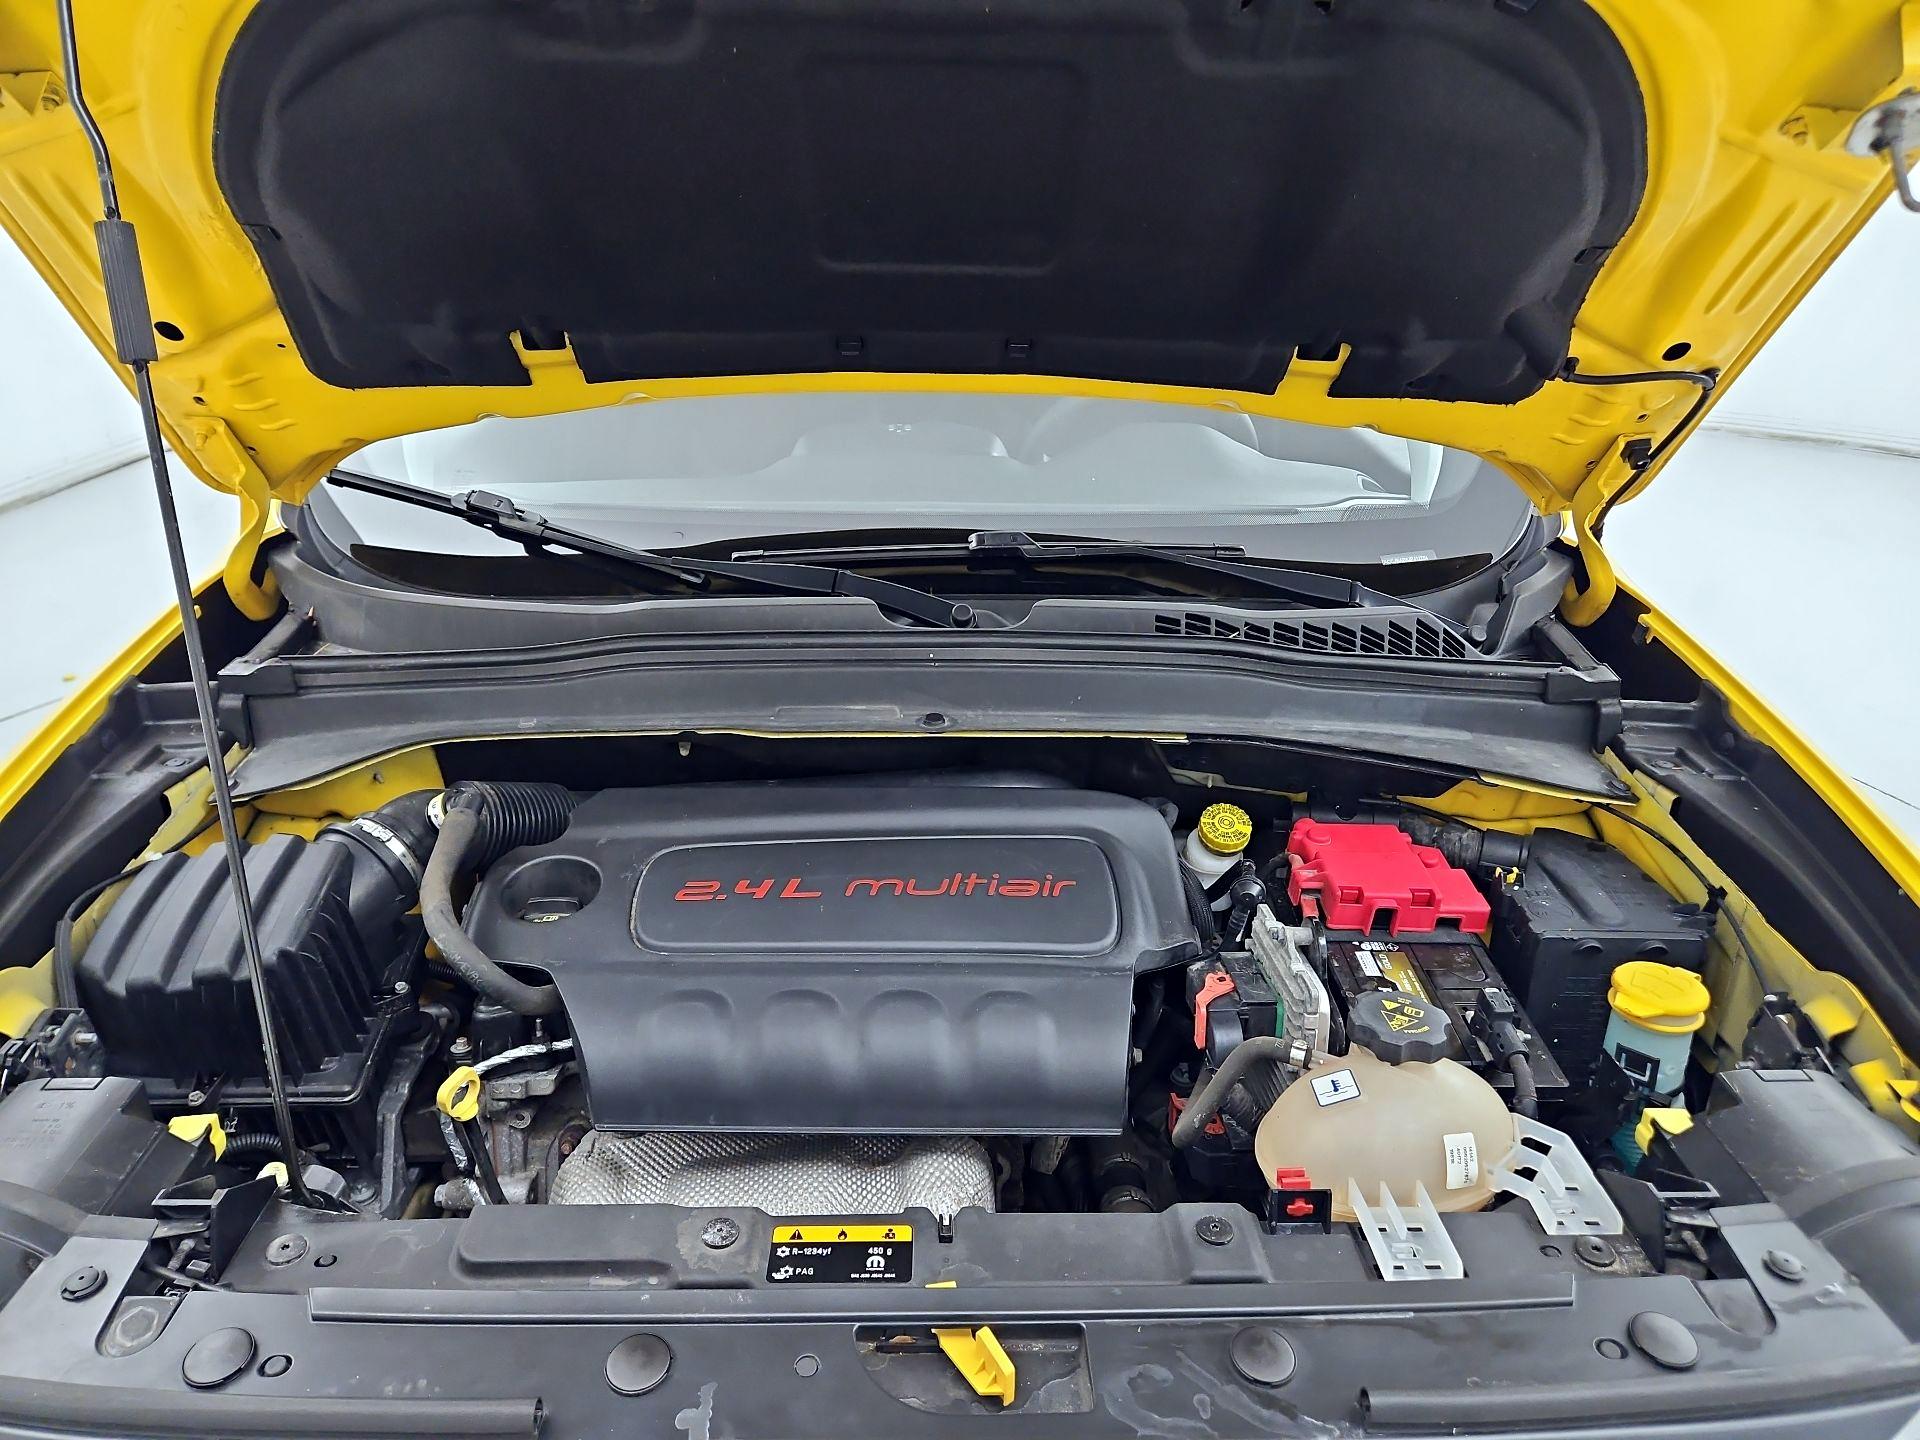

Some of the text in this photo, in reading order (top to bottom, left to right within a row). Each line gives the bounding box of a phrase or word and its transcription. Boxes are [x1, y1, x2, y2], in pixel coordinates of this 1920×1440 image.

[674, 872, 1077, 901] 2.4L multiair
[791, 1247, 893, 1257] R-1234yf 450 g
[795, 1267, 814, 1276] PAG
